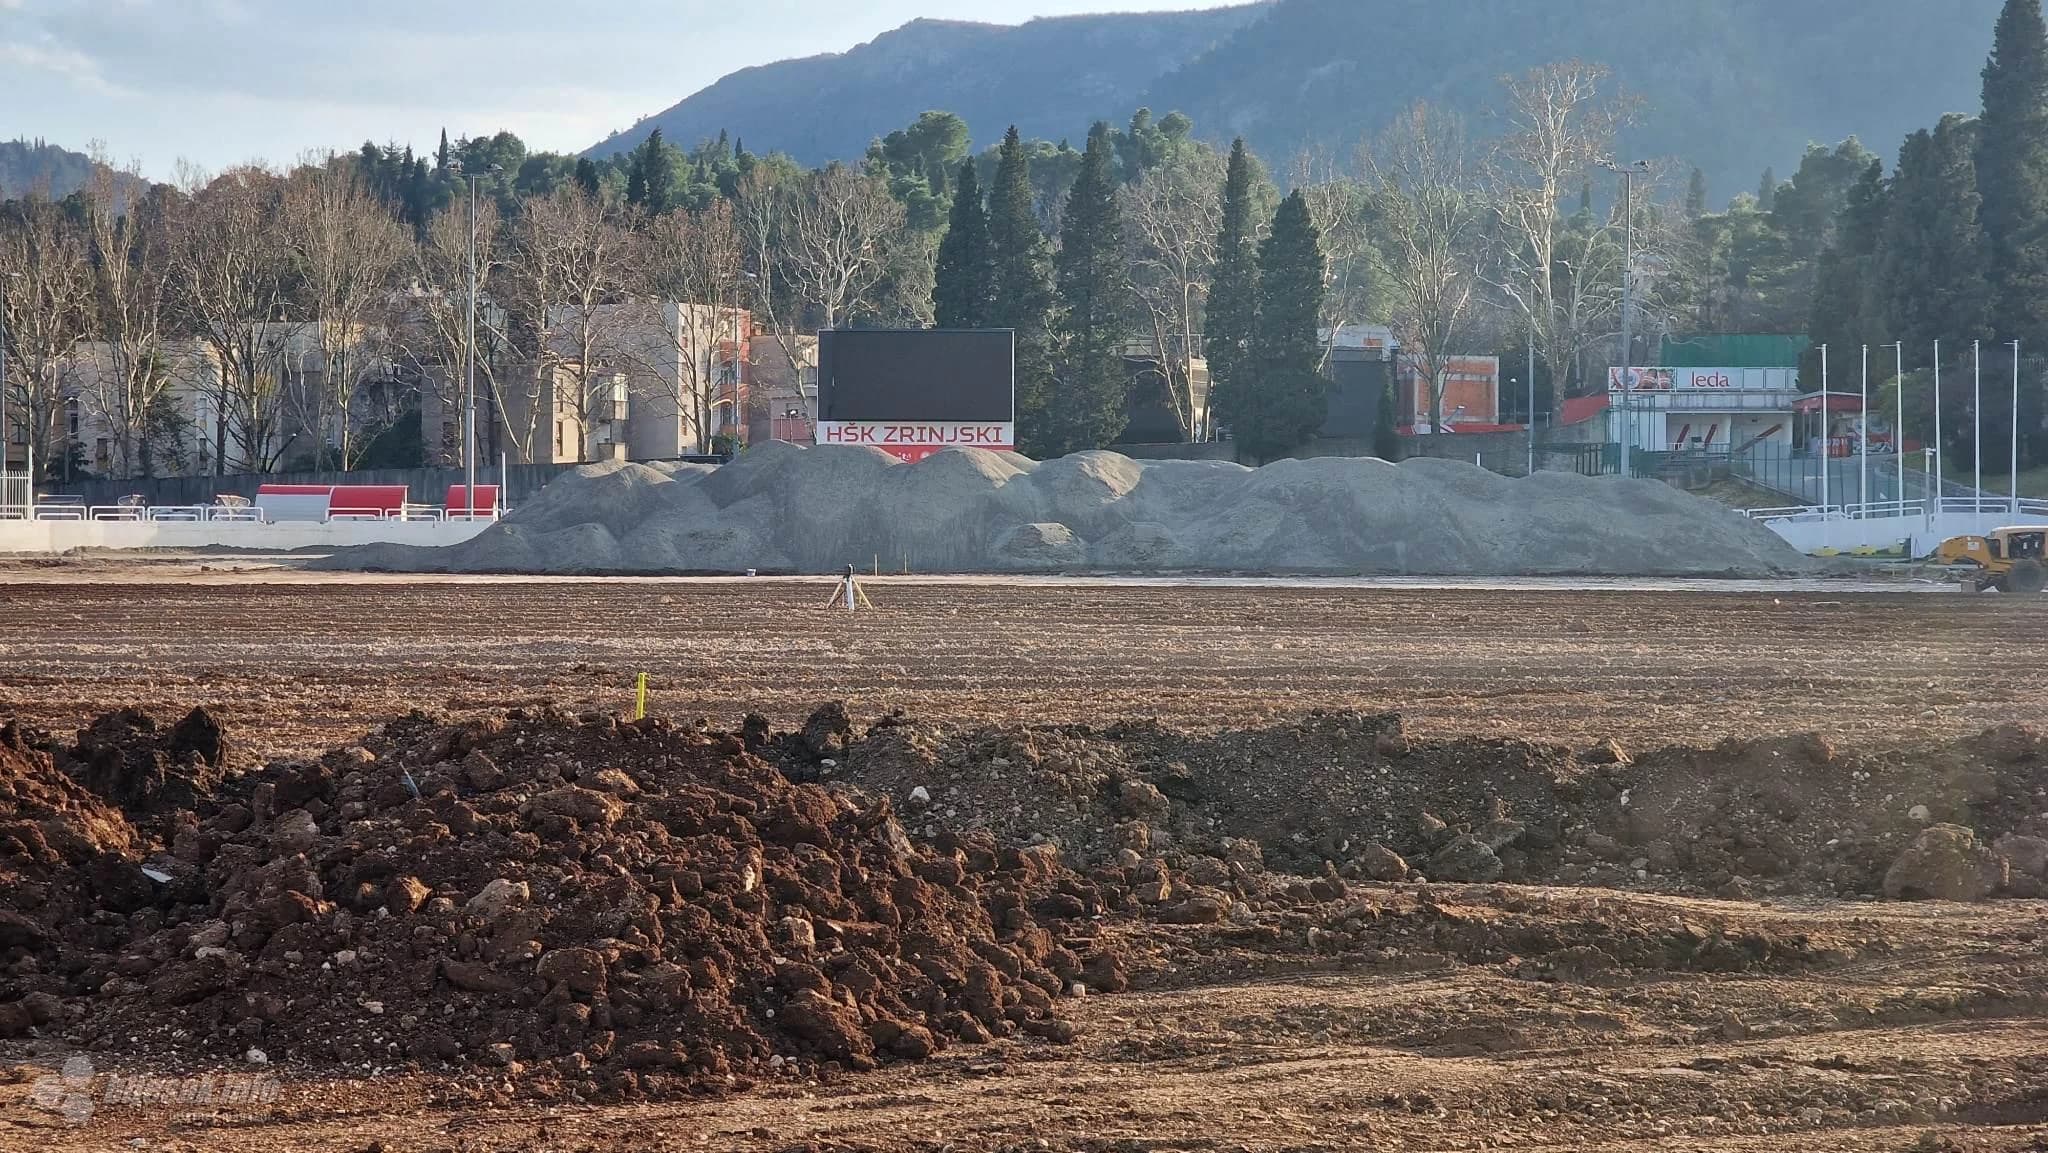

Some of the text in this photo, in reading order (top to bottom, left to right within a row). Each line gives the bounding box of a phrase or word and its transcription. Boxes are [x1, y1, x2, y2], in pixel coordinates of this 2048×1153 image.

[1691, 371, 1730, 388] leda
[827, 423, 1003, 442] HŠK ZRINJSKI
